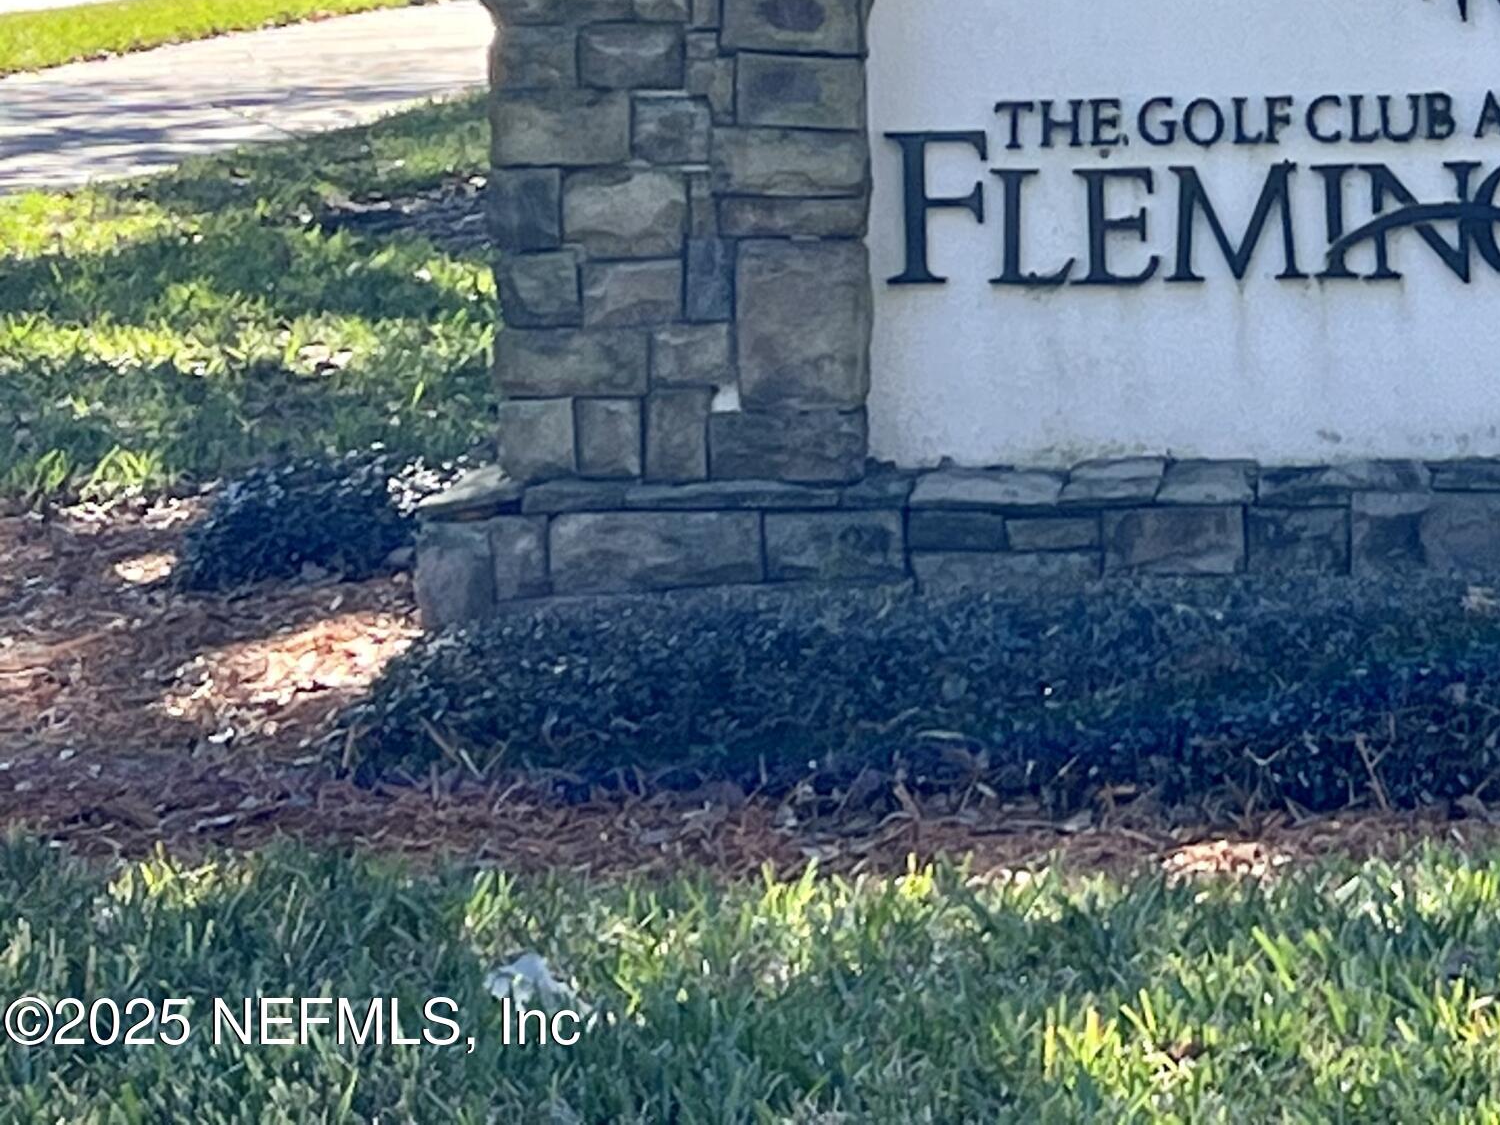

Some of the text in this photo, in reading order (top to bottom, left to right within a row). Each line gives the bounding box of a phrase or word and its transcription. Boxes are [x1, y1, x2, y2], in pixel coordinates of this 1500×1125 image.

[994, 97, 1121, 150] THE
[1137, 94, 1292, 146] GOLF
[1305, 92, 1456, 143] CLUB
